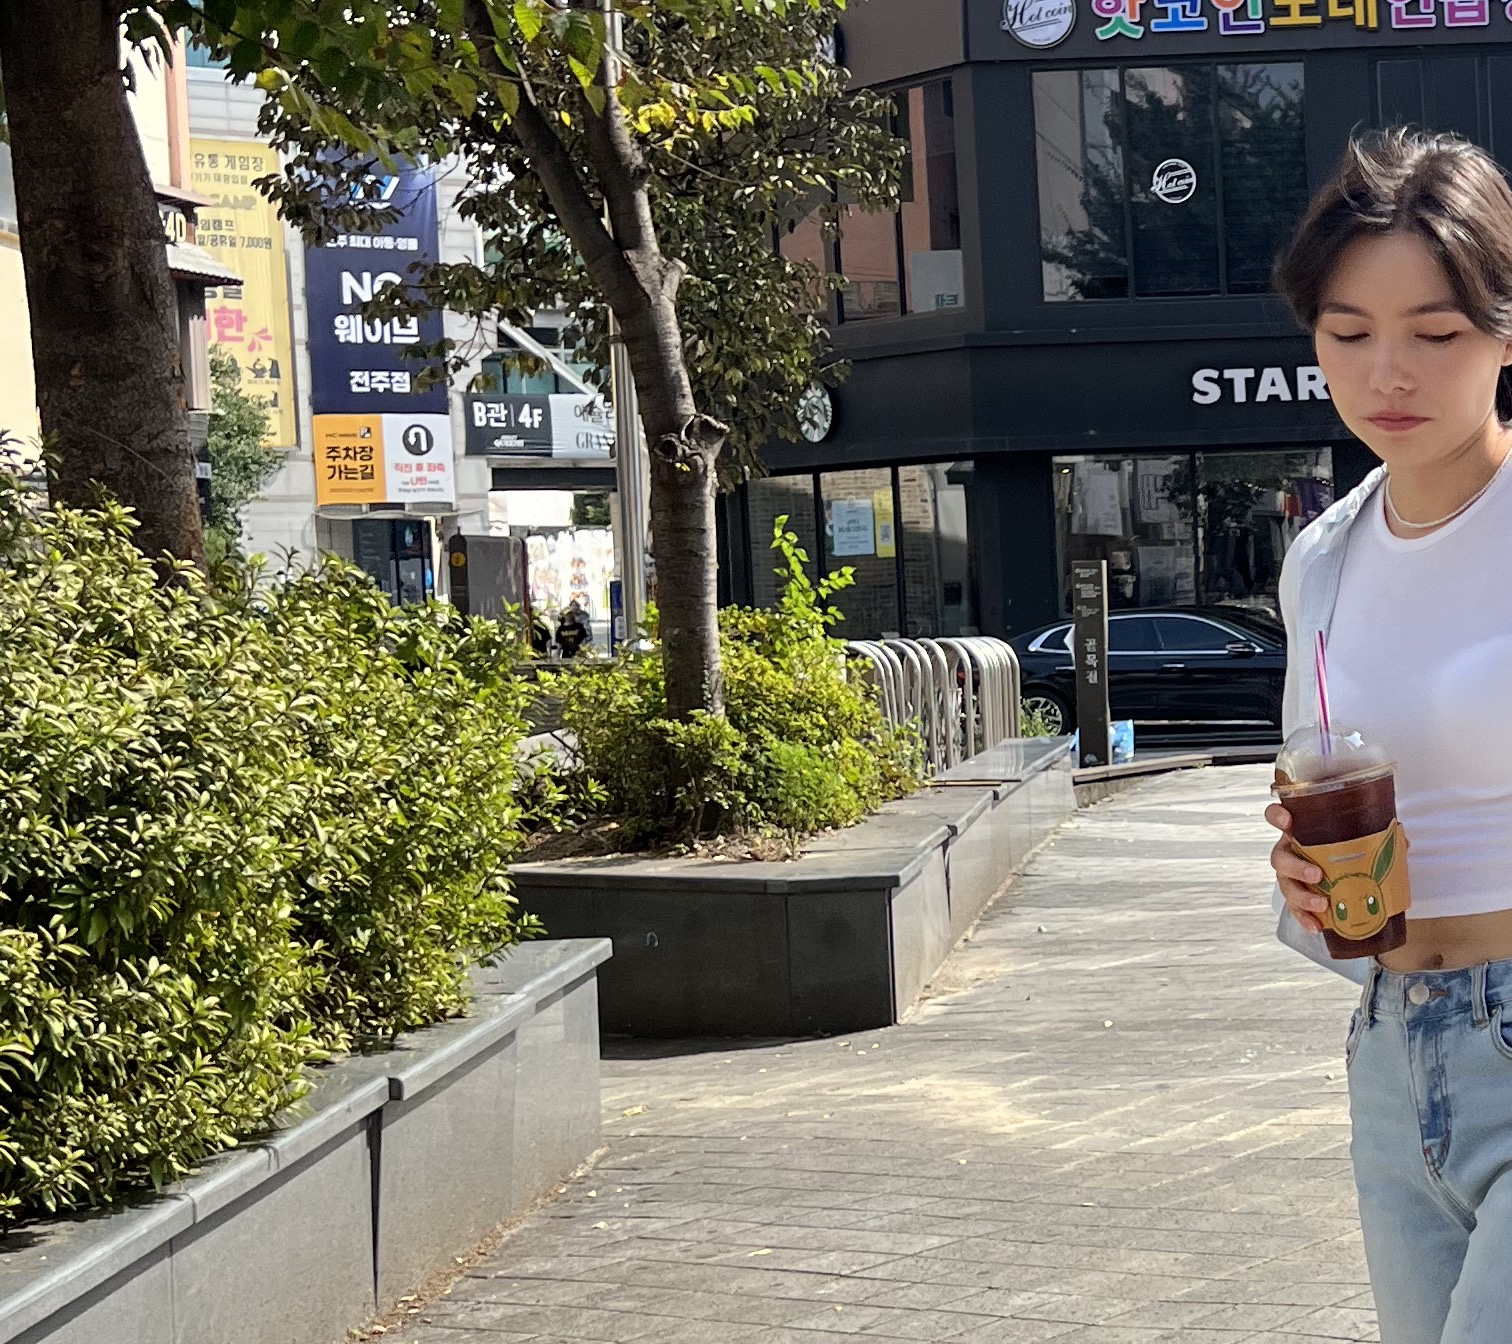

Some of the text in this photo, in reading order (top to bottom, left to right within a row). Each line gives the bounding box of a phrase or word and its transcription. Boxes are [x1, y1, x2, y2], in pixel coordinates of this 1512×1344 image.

[349, 370, 411, 394] 전주점
[472, 401, 508, 428] B관
[325, 446, 374, 462] 주차장
[327, 464, 375, 481] 가는길
